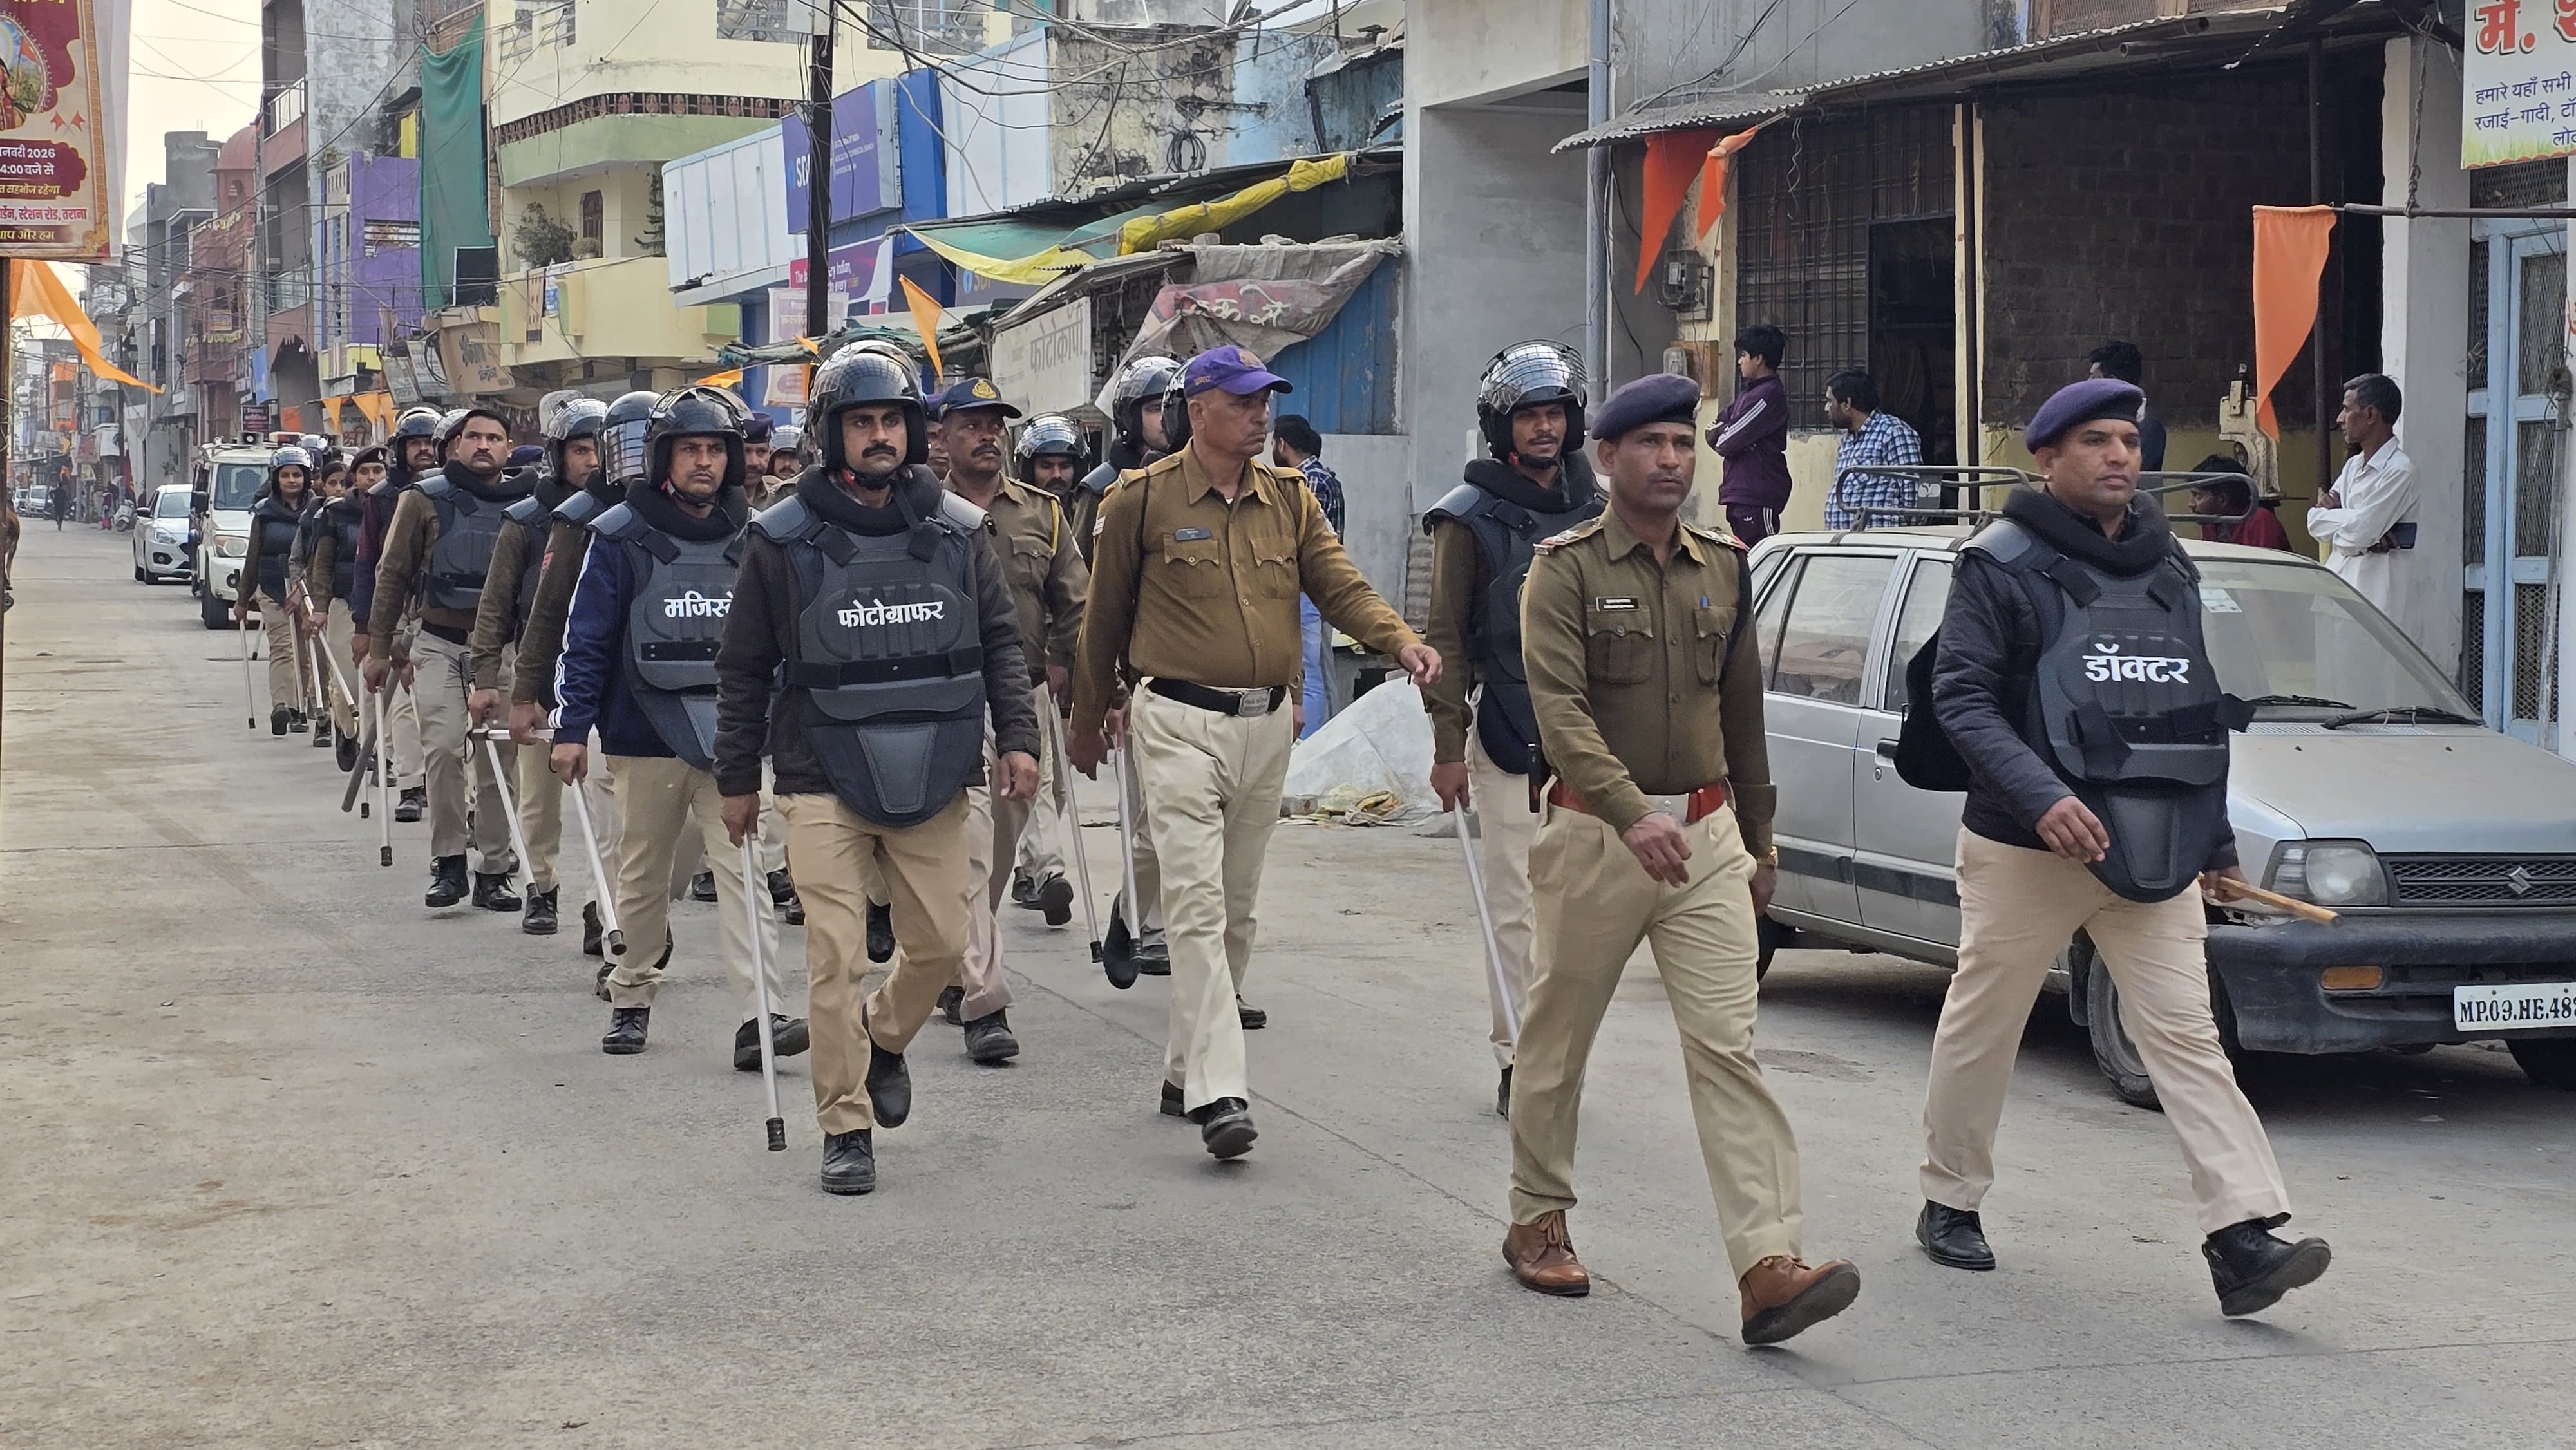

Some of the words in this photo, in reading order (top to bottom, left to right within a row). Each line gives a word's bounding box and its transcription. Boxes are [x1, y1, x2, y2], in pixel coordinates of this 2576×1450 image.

[2476, 82, 2508, 105] हमारे
[2512, 77, 2537, 98] यहाँ
[2542, 71, 2571, 93] सभी
[27, 148, 55, 158] 2026
[43, 162, 54, 175] से
[37, 183, 61, 194] रहेगा
[18, 205, 43, 220] स्टेशन
[44, 205, 61, 221] रोड,
[62, 209, 87, 220] तराना
[837, 599, 945, 628] फोटोग्राफर
[2082, 643, 2190, 684] डॉक्टर
